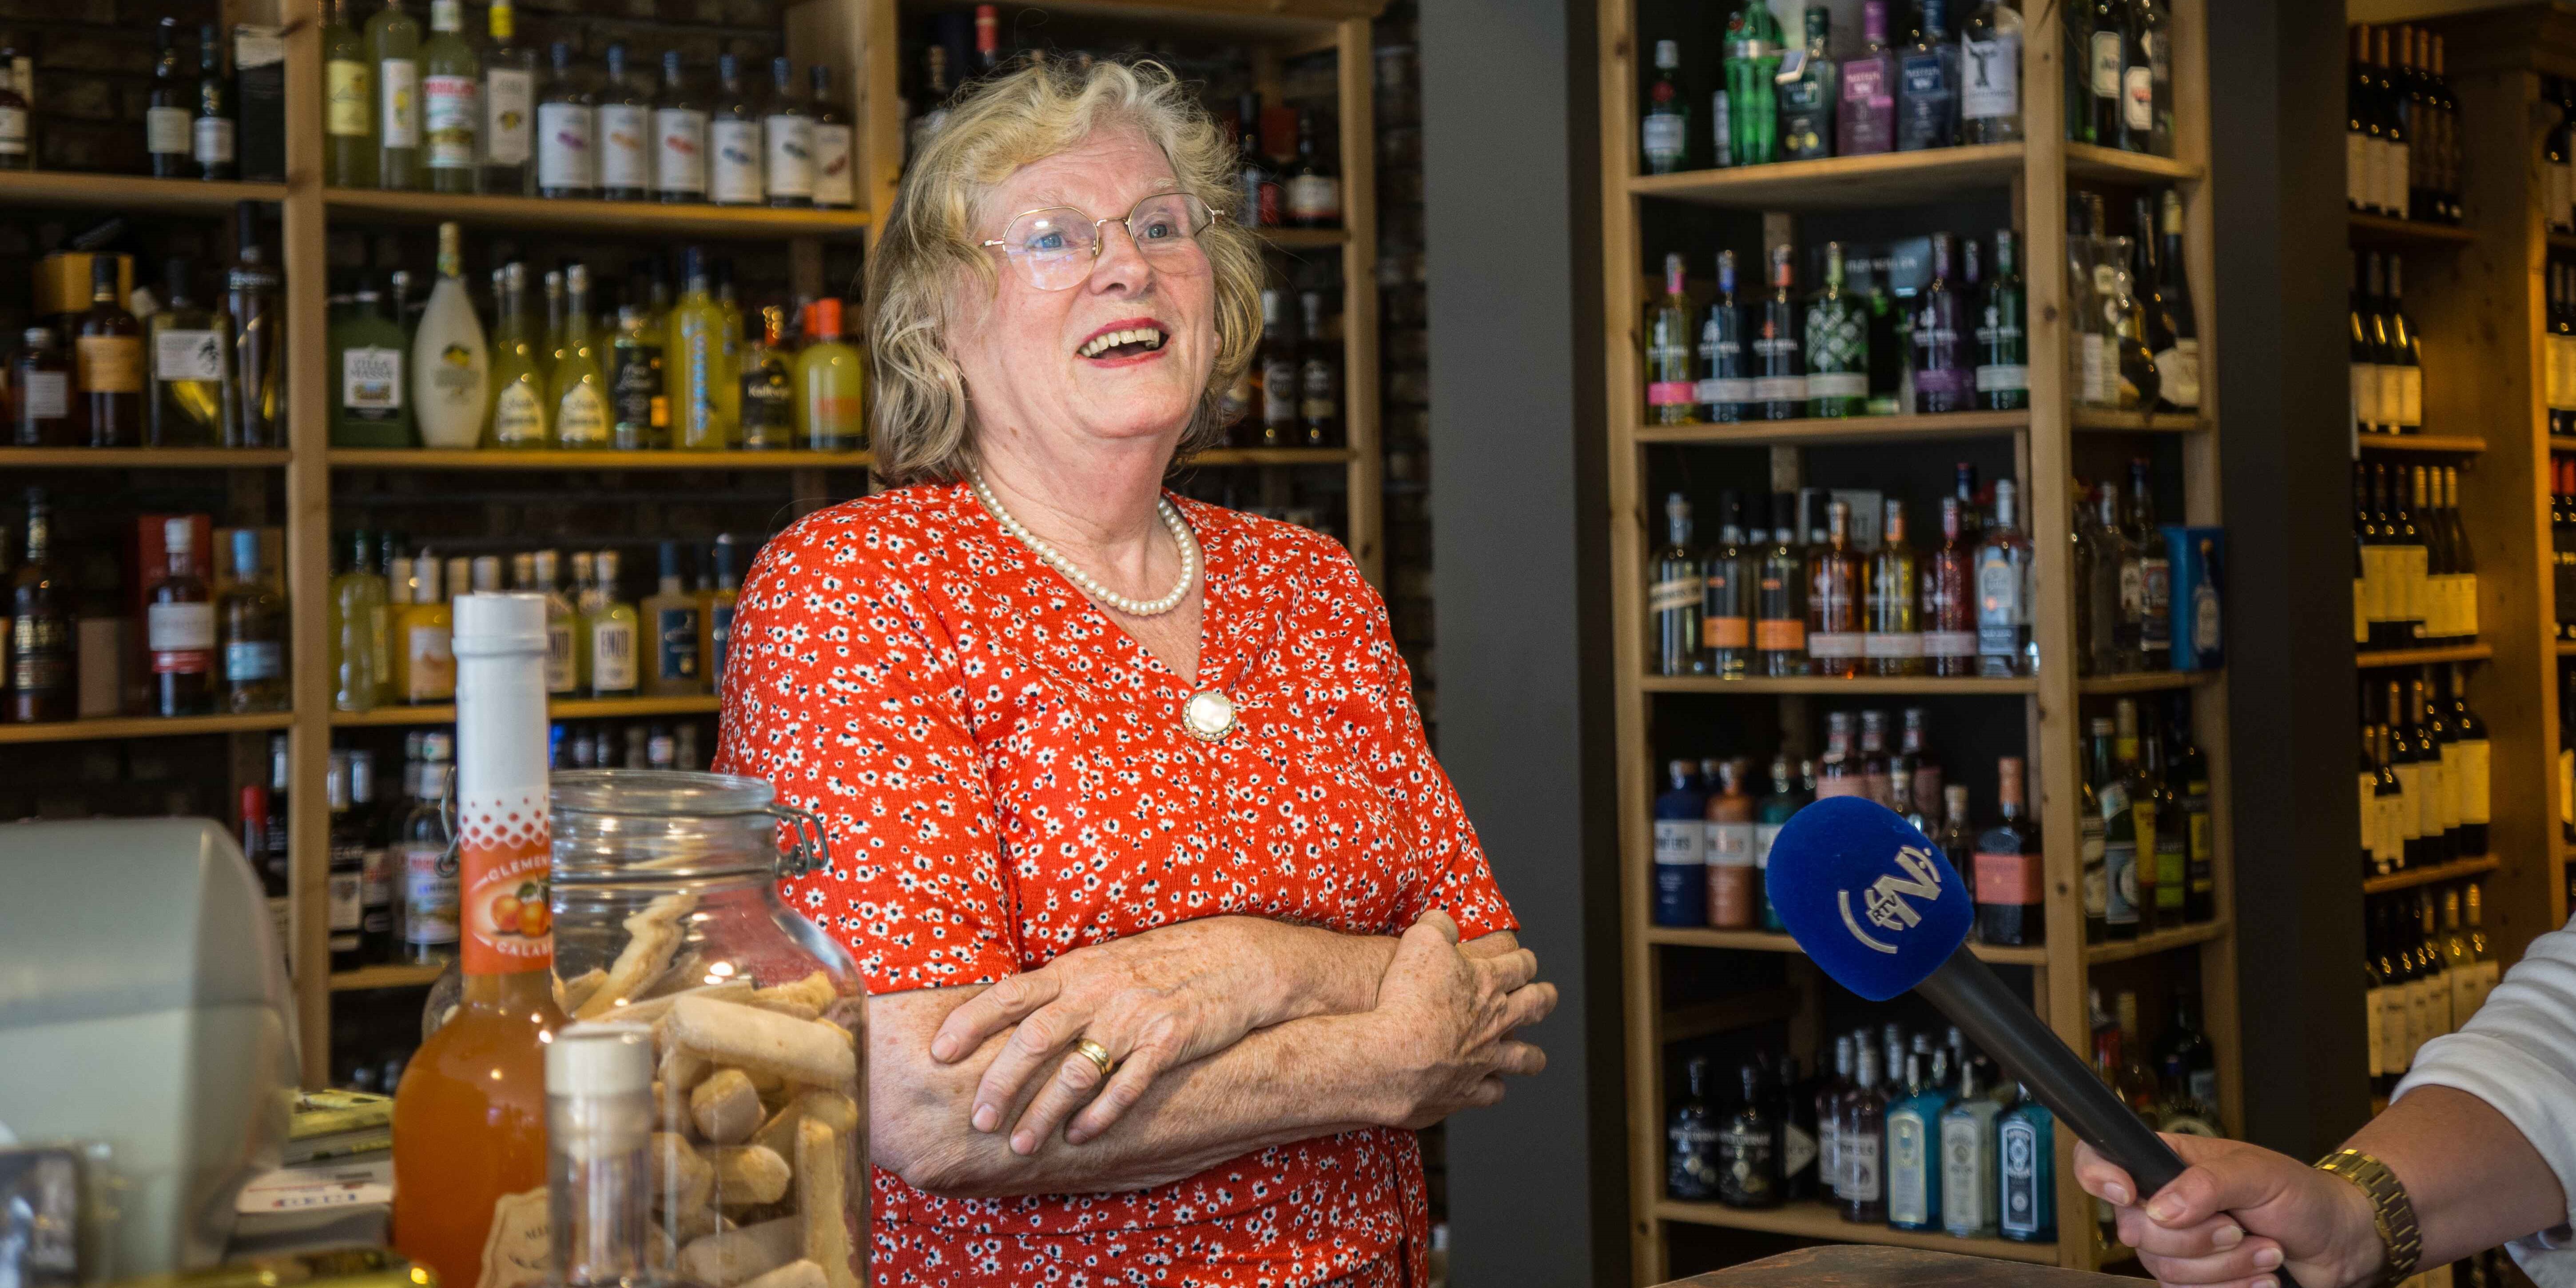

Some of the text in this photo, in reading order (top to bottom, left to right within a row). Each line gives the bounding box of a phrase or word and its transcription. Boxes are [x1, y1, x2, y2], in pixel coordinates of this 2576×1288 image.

[488, 855, 551, 881] CLEMEN
[1872, 894, 1897, 922] RTV
[496, 941, 551, 958] CALAB
